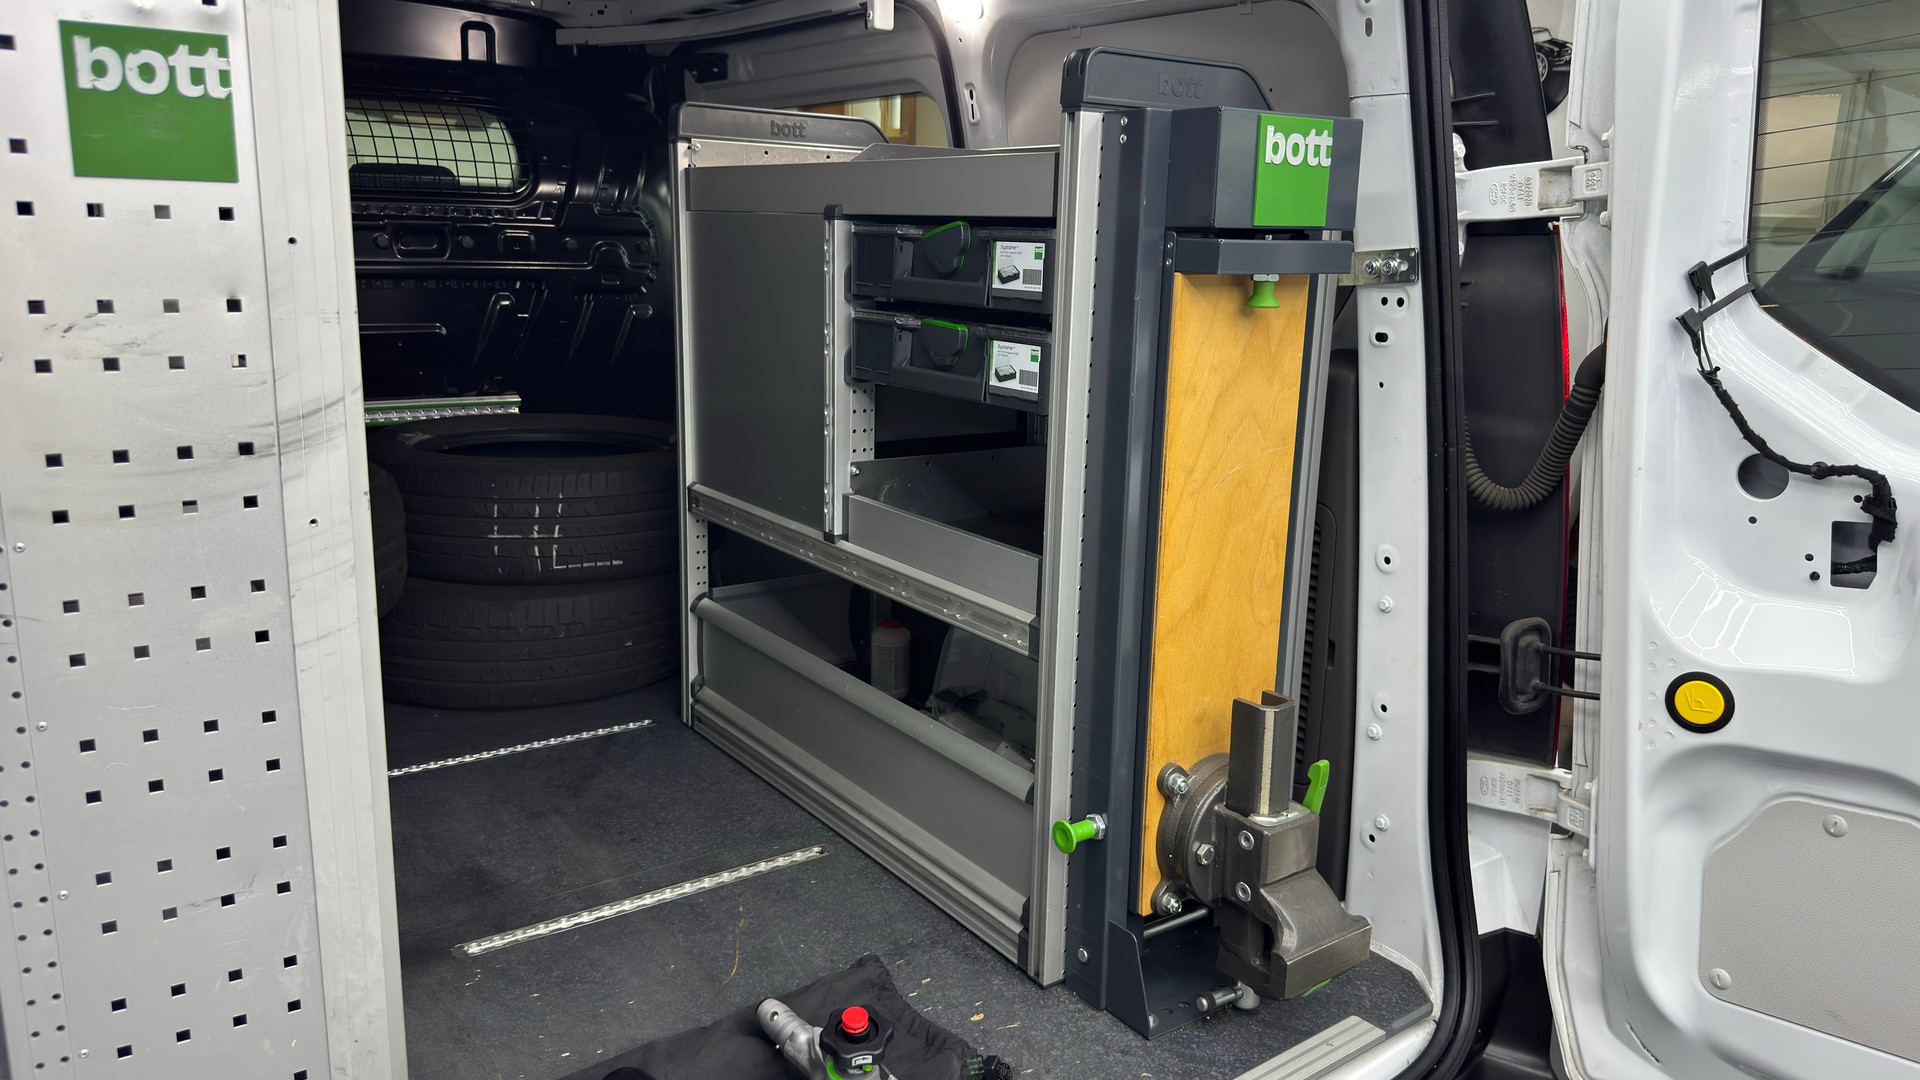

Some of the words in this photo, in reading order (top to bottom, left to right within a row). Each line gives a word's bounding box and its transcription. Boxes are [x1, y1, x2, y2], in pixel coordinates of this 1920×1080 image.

[72, 35, 232, 99] bott
[1157, 69, 1204, 99] bott
[770, 119, 807, 138] bott
[1265, 125, 1333, 167] bott
